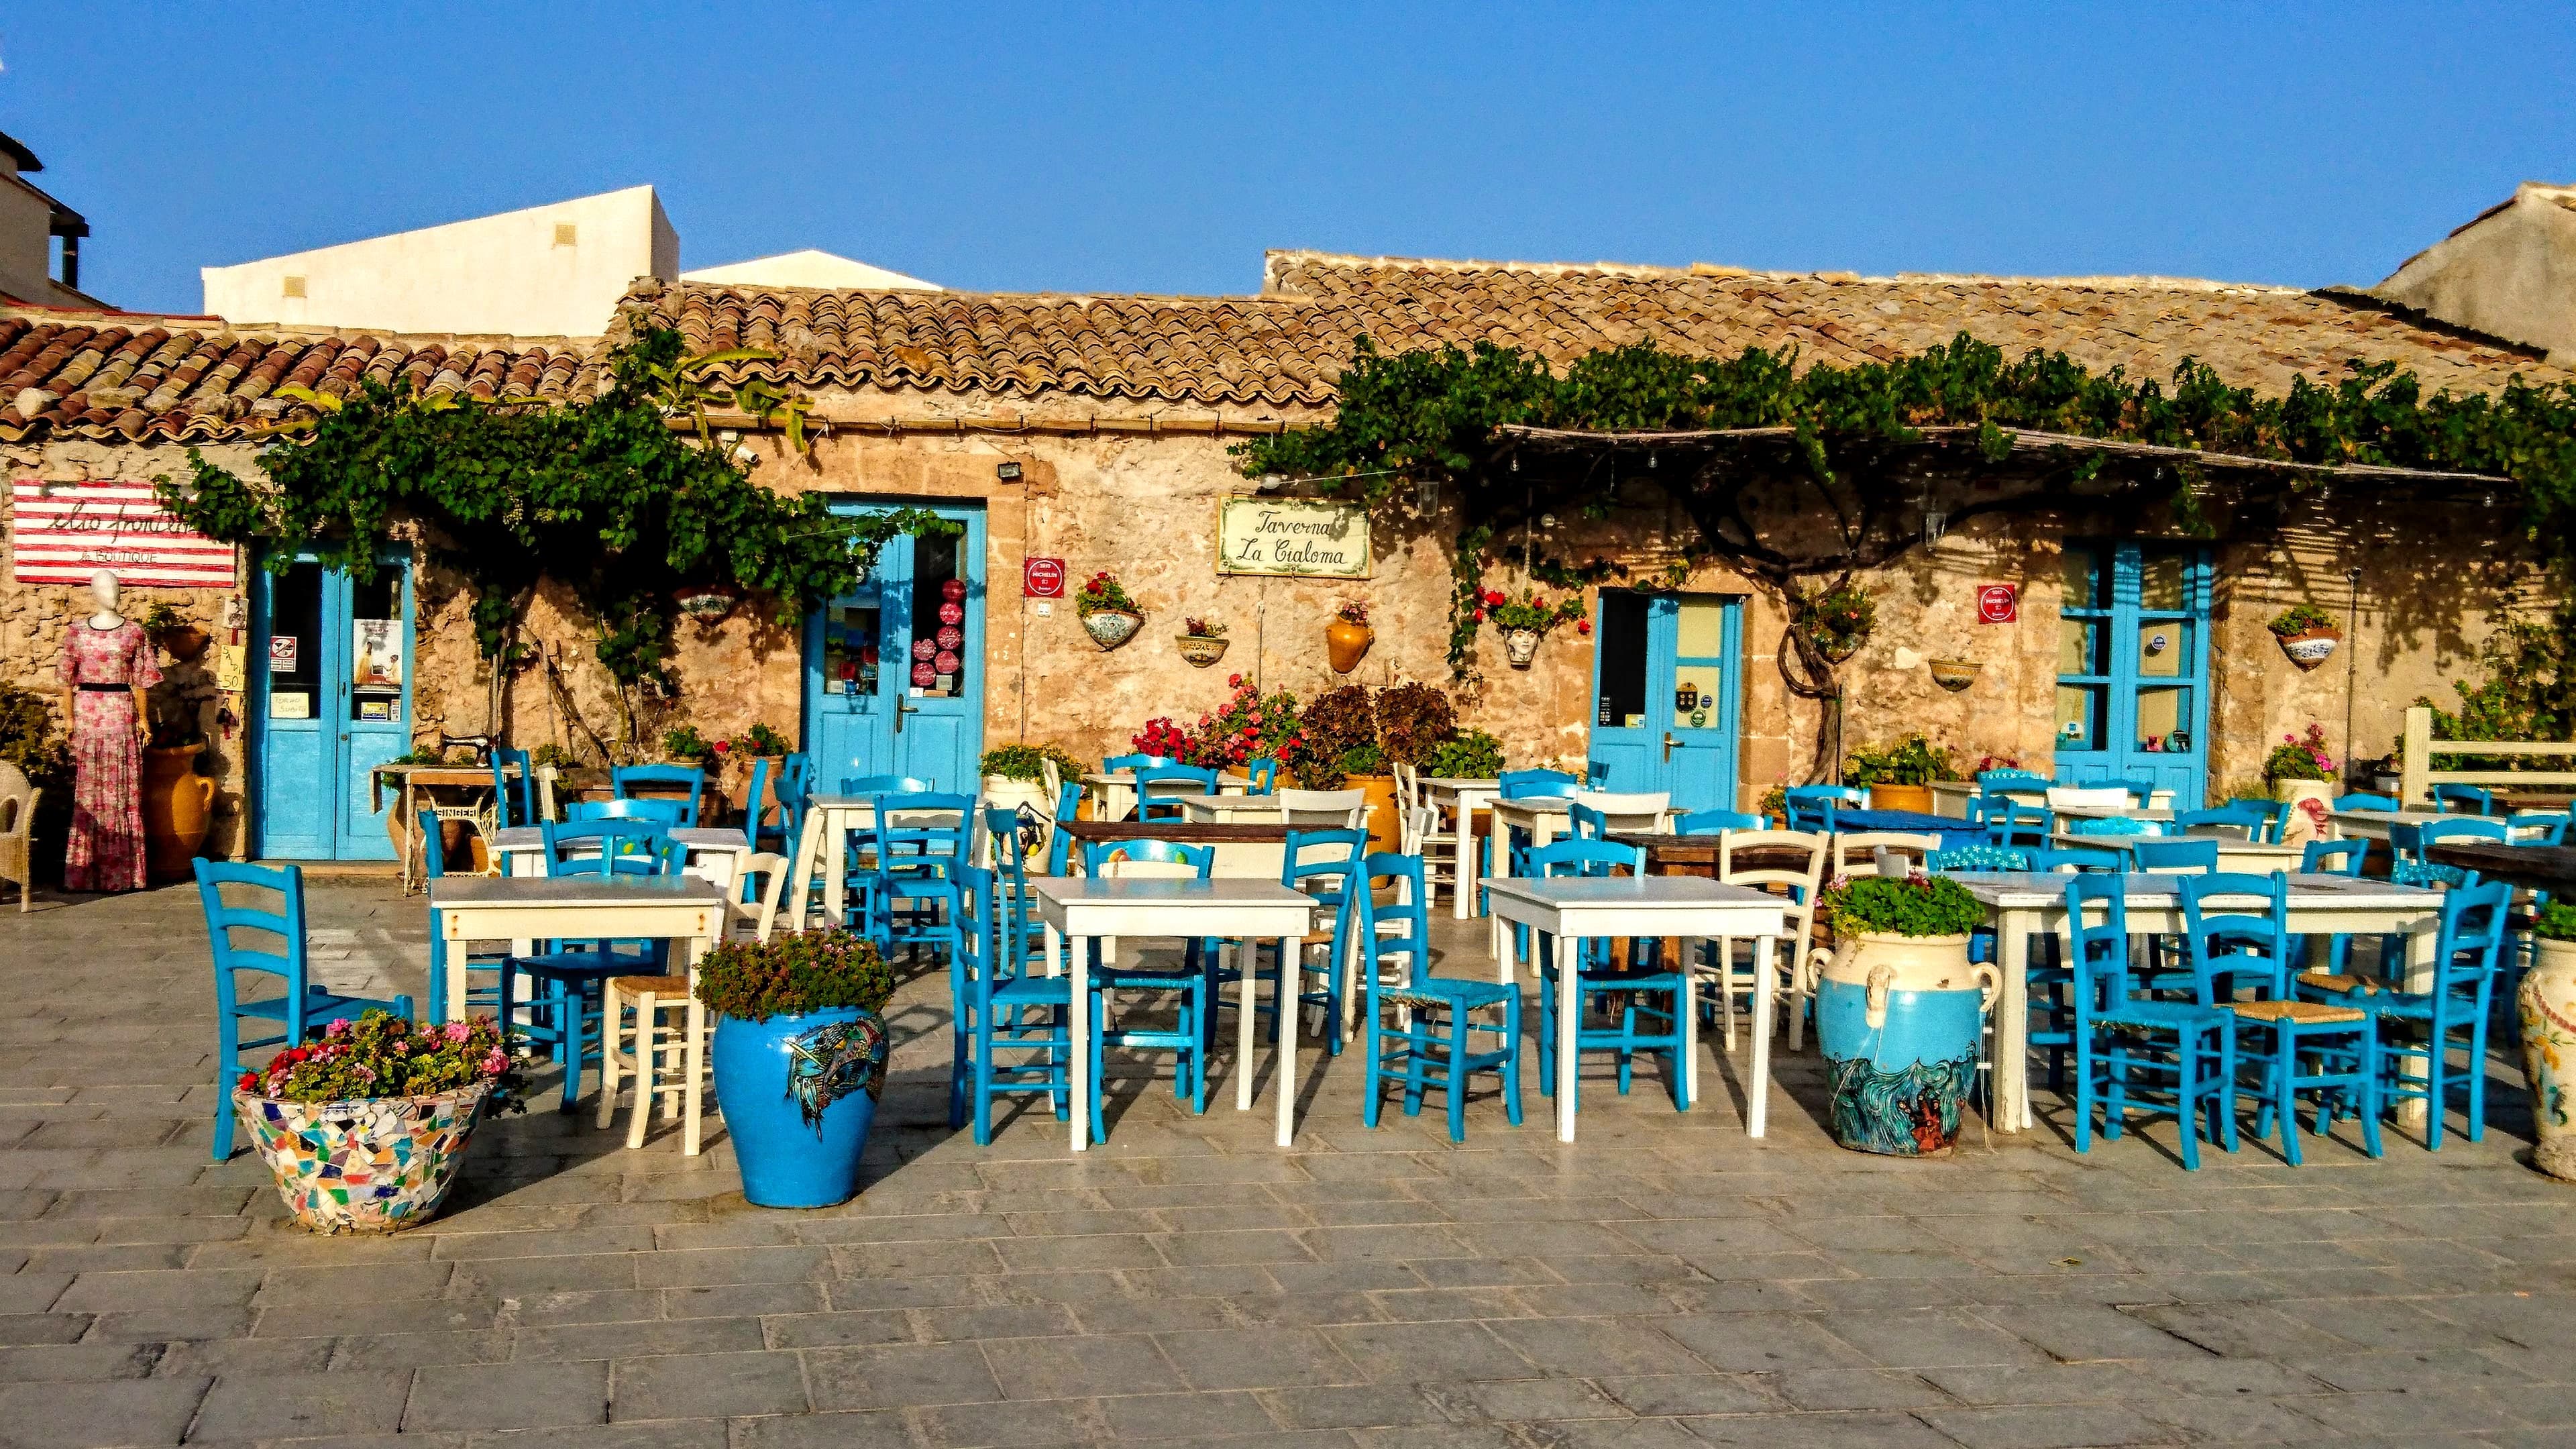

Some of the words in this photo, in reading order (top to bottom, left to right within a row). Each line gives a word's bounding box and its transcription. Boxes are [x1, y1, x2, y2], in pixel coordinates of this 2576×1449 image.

[1255, 511, 1330, 535] Taverna
[96, 551, 158, 564] BOUTIQUE
[1236, 538, 1265, 562] La
[1275, 539, 1347, 564] Cialoma
